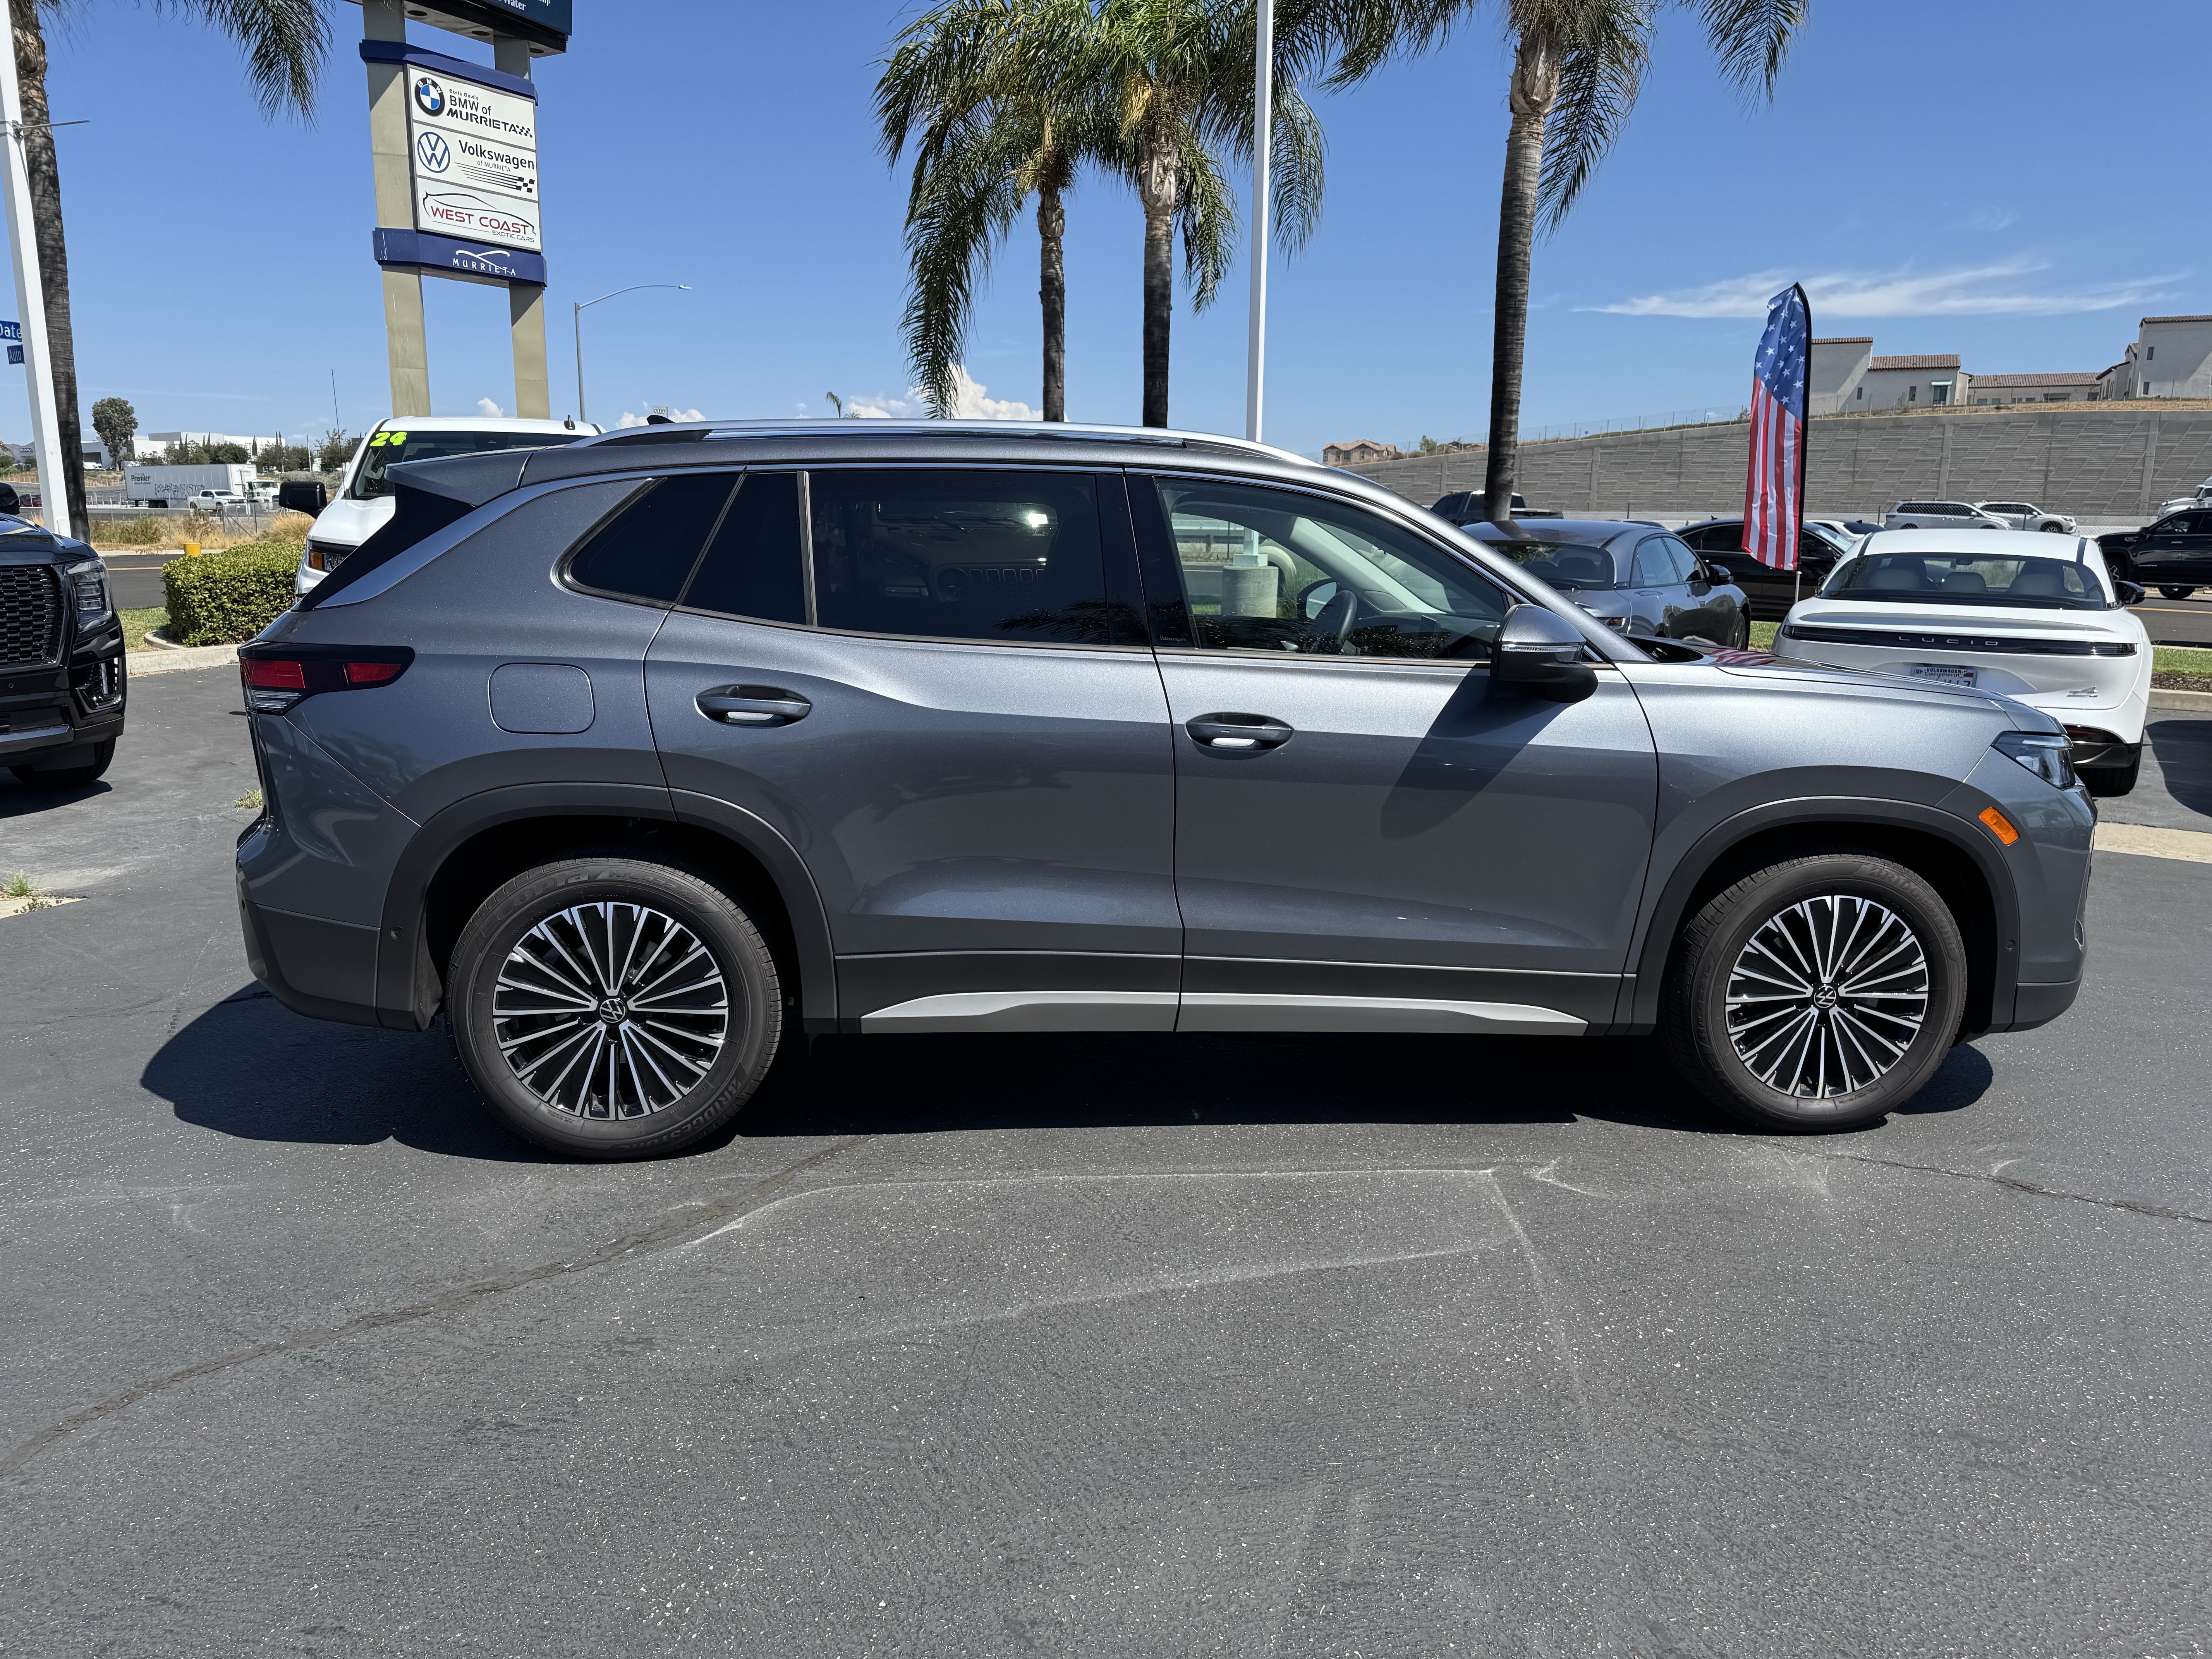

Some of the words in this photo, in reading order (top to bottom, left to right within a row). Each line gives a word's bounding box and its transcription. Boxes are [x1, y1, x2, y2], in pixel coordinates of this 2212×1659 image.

[417, 79, 442, 93] BMW
[450, 95, 479, 112] BMW
[482, 106, 491, 116] of
[446, 108, 518, 135] MURRIETA
[459, 140, 534, 170] Volkswagen
[484, 161, 511, 172] MURRIETA
[431, 206, 474, 224] WEST
[479, 216, 529, 235] COAST
[492, 230, 515, 239] EXOTIC
[517, 235, 535, 243] CARS
[453, 258, 516, 276] MURRIETA
[9, 349, 22, 362] Auto
[370, 432, 407, 447] 24
[1899, 636, 1998, 646] LUCID
[1867, 868, 1956, 953] BRIDGESTONE
[619, 1077, 742, 1151] BRIDGESTONE
